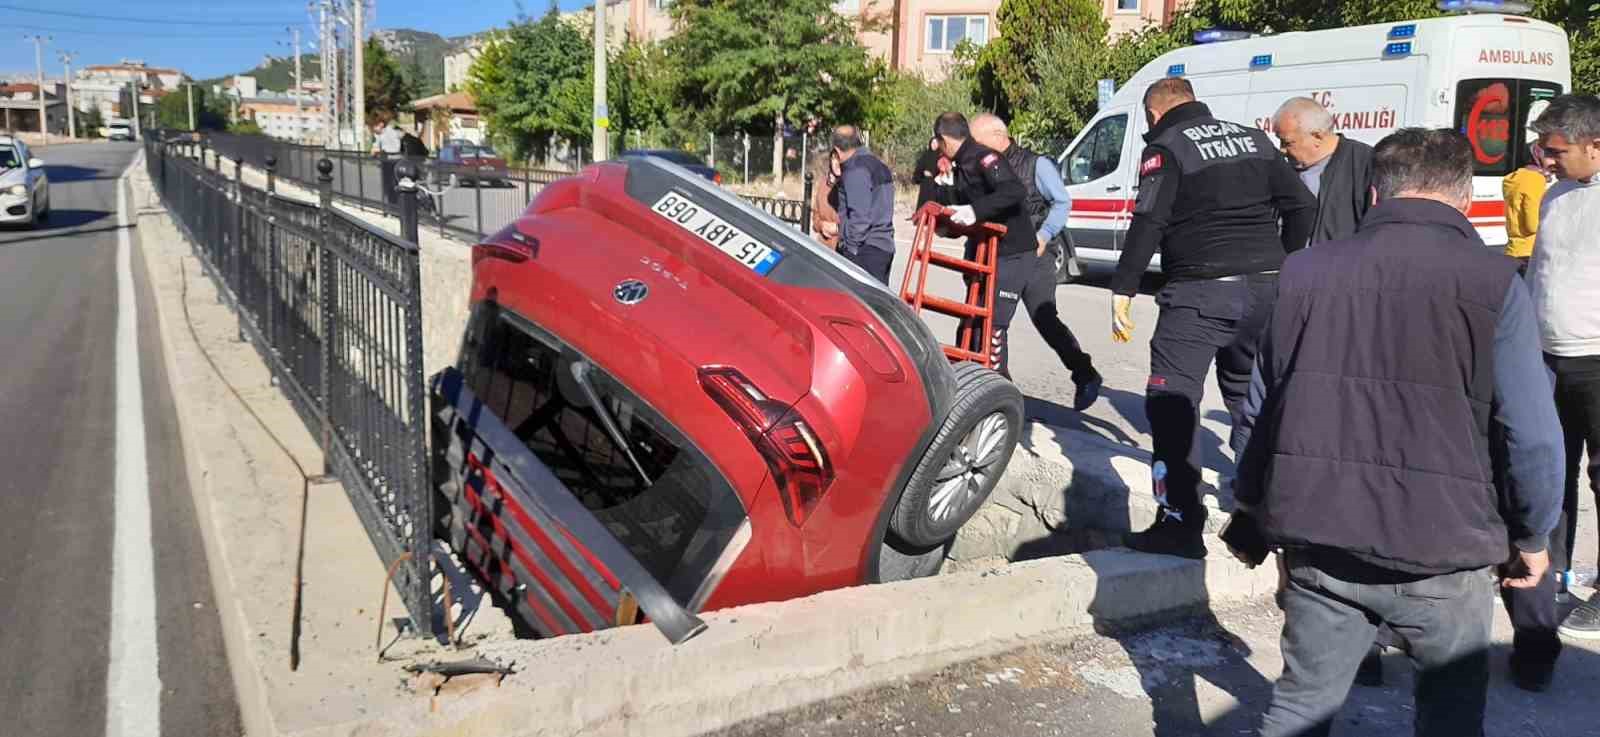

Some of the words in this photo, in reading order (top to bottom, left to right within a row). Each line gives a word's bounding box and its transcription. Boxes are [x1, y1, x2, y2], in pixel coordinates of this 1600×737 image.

[1478, 49, 1554, 66] AMBULANS
[1311, 91, 1335, 108] TC.
[1330, 107, 1396, 130] KANLIĞI
[657, 196, 698, 224] 068
[694, 219, 739, 246] ABY
[736, 241, 765, 265] 15
